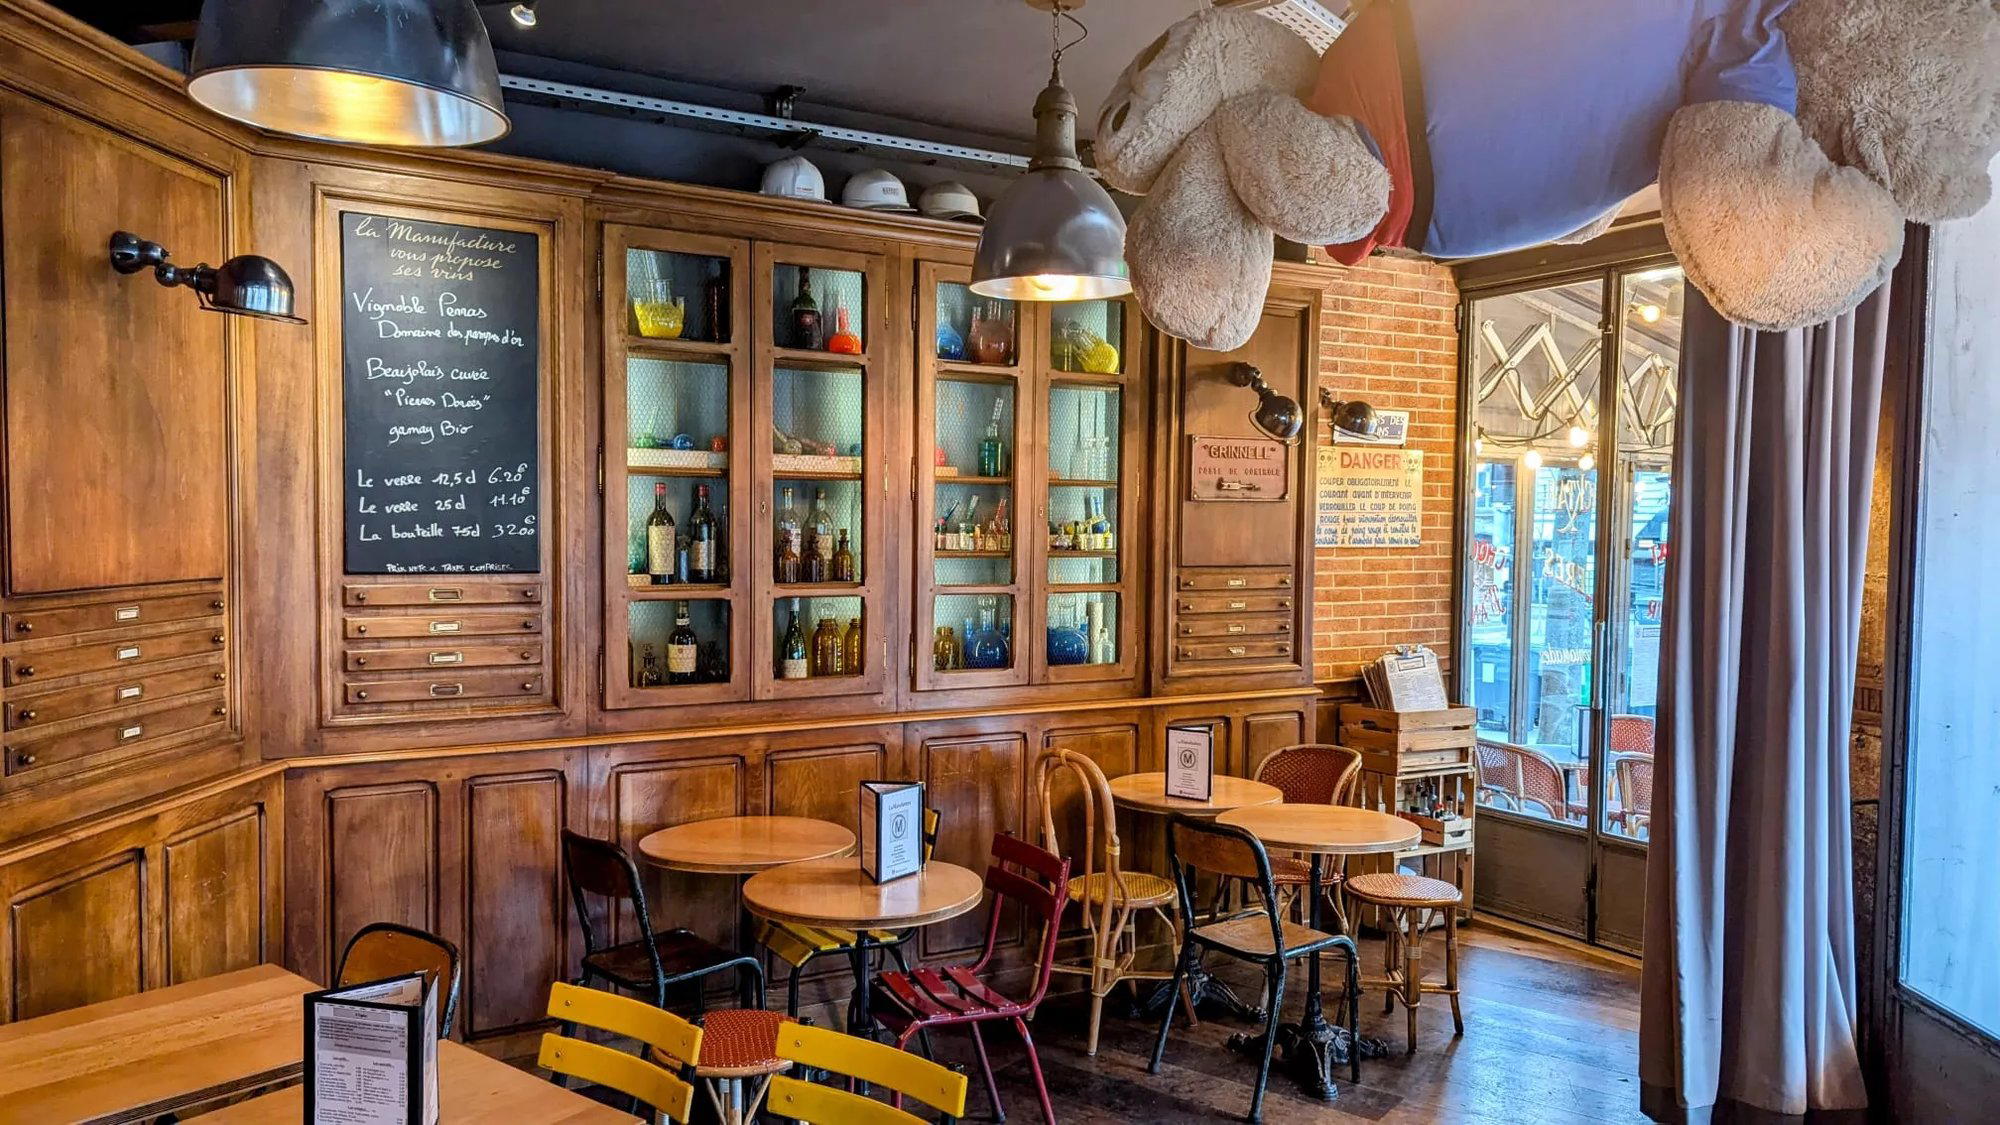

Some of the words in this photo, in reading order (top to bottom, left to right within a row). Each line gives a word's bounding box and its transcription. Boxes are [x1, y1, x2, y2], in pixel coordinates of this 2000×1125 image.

[385, 222, 517, 254] Manufacture
[390, 248, 427, 261] vous
[430, 253, 503, 273] propose
[392, 265, 422, 277] ses
[430, 267, 474, 281] vins
[353, 287, 427, 319] Vignoble
[378, 320, 441, 339] Domaine
[365, 357, 444, 385] Beaujolais
[387, 425, 435, 445] gamay
[440, 420, 474, 436] Bio
[1340, 451, 1401, 470] DANGER
[358, 469, 374, 488] Le
[432, 472, 462, 488] 12,5
[1229, 467, 1238, 476] DE
[359, 496, 378, 513] Le
[435, 499, 453, 512] 25
[360, 524, 382, 541] La
[391, 522, 444, 539] bouteille
